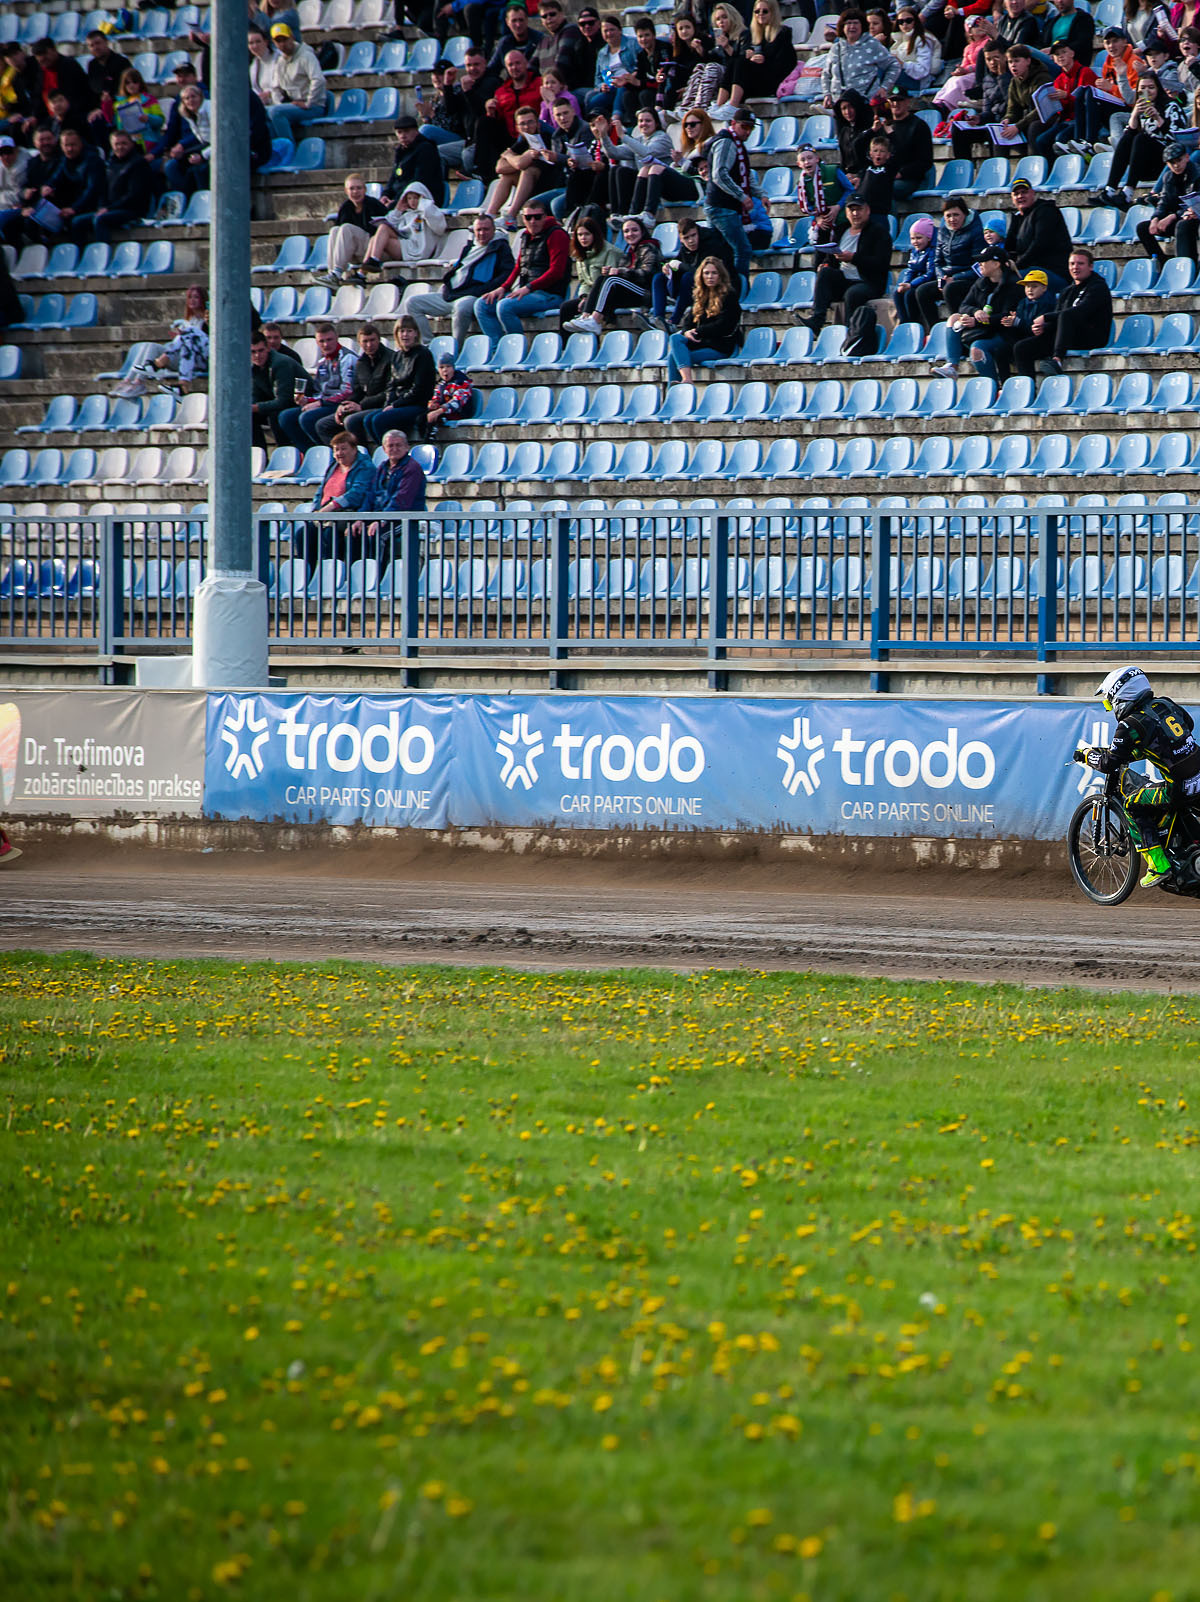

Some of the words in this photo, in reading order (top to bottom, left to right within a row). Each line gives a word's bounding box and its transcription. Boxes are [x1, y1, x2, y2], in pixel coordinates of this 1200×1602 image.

[1165, 716, 1184, 737] 6
[24, 738, 51, 766] Dr.
[54, 738, 145, 767] Trofimova
[277, 710, 435, 775] trodo
[552, 723, 705, 783] trodo
[832, 727, 995, 789] trodo
[24, 773, 144, 797] zobārstniecības
[148, 778, 201, 802] prakse
[286, 786, 317, 805] CAR
[321, 787, 371, 808] PARTS
[375, 790, 431, 810] ONLINE
[560, 795, 591, 814] CAR
[595, 796, 643, 815] PARTS
[646, 797, 702, 816] ONLINE
[841, 801, 873, 820] CAR
[879, 802, 930, 821] PARTS
[934, 803, 994, 823] ONLINE
